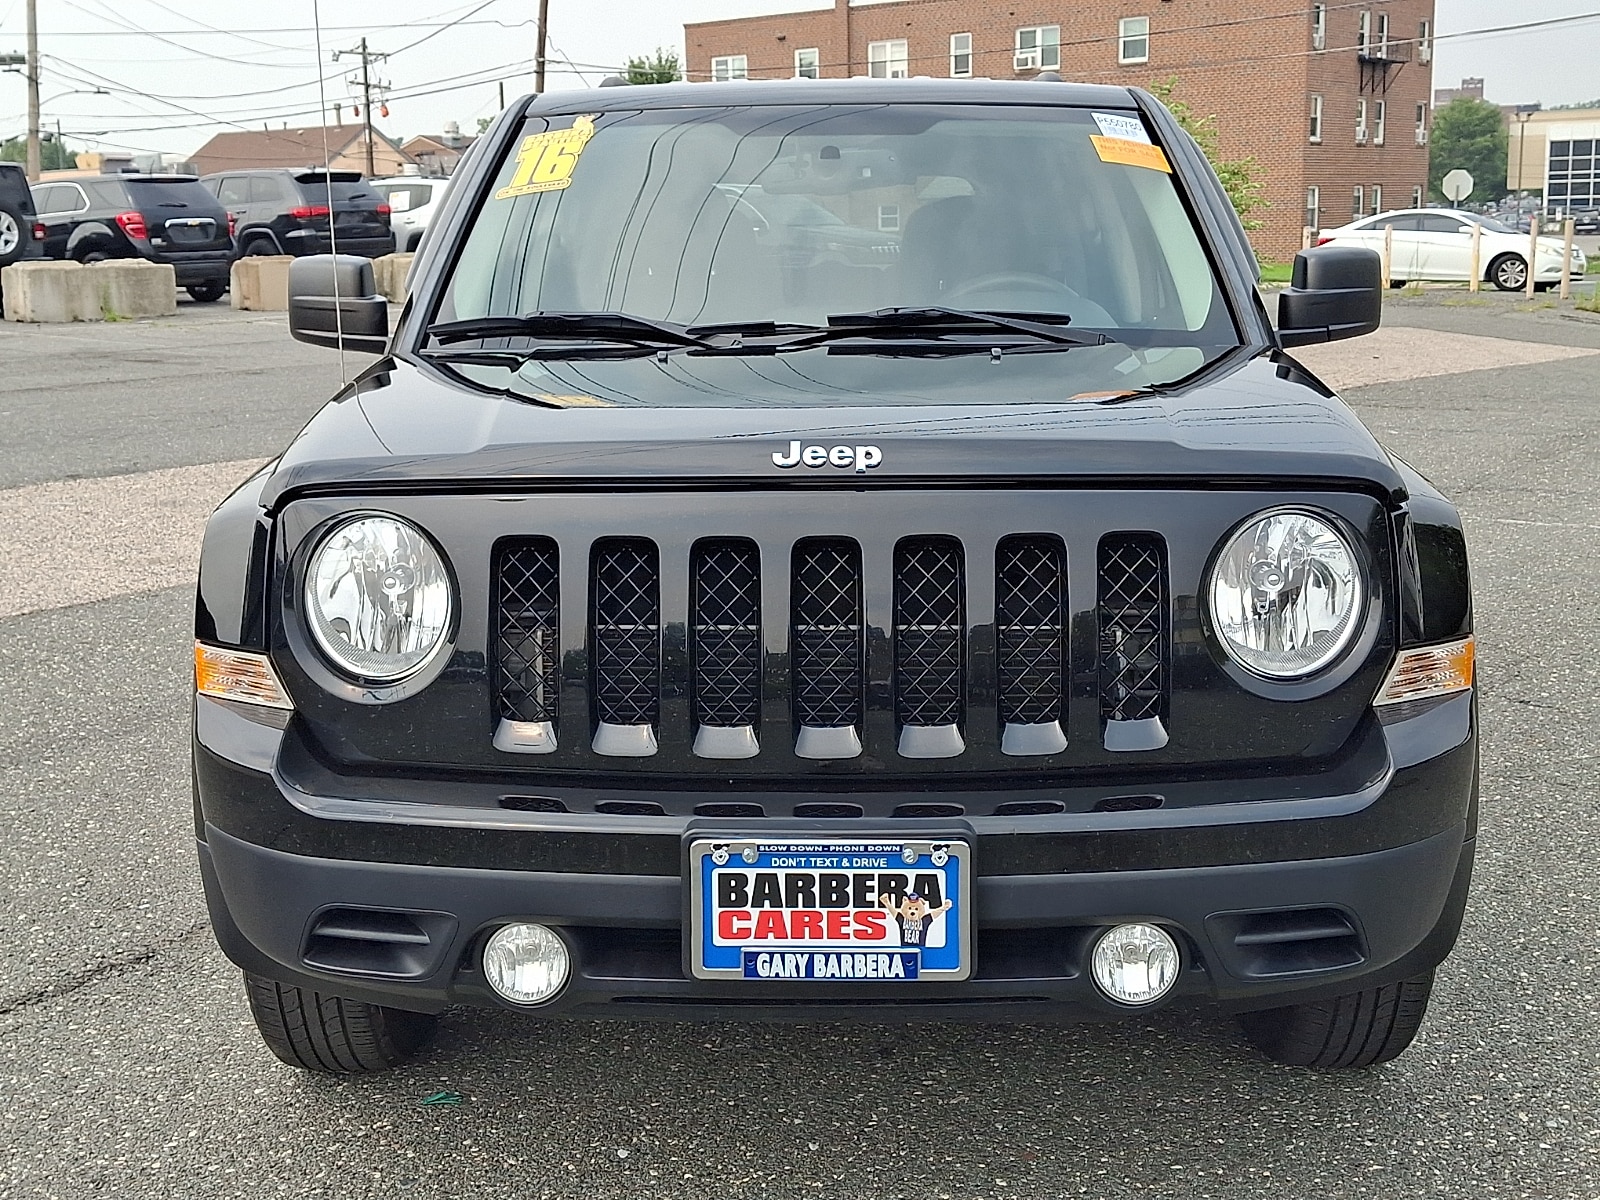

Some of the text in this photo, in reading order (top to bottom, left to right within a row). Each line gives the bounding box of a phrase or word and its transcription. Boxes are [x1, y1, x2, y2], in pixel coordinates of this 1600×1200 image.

[512, 142, 580, 187] 16
[771, 440, 883, 474] Jeep
[771, 857, 888, 867] DON'T TEXT & DRIVE
[717, 872, 943, 909] BARBERA
[718, 910, 886, 940] CARES
[904, 929, 920, 944] BEAR
[757, 953, 905, 978] GARY BARBERA
